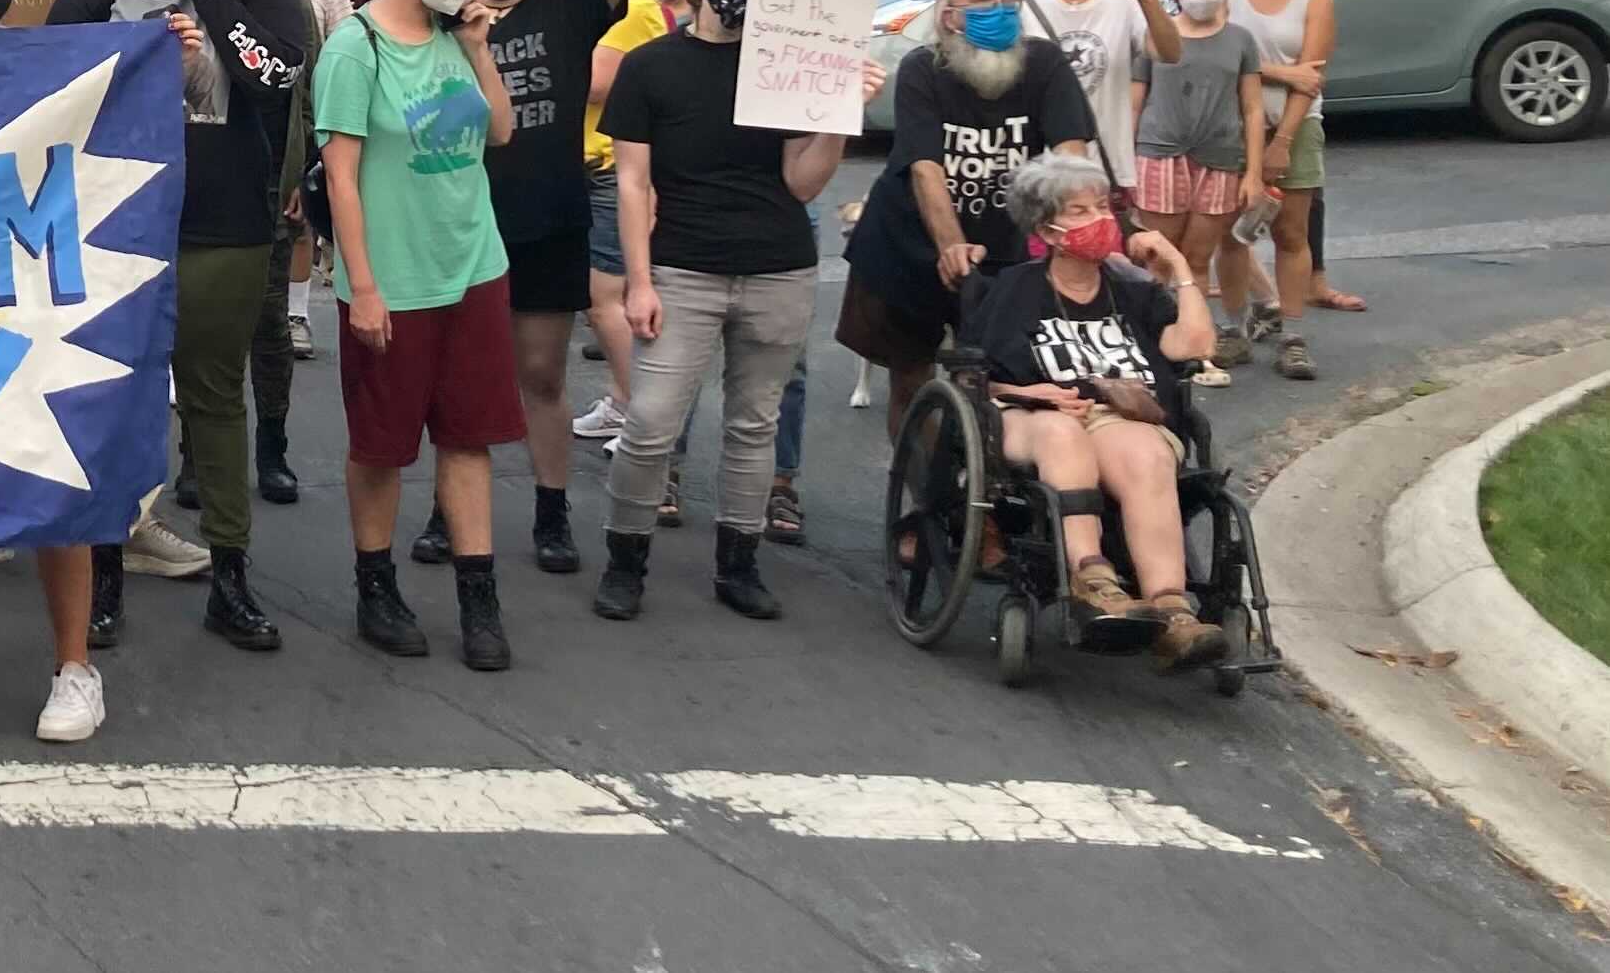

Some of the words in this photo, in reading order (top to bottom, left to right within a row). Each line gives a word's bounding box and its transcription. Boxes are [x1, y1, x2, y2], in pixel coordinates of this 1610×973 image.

[489, 32, 548, 65] ACK
[779, 44, 859, 73] FUCKING
[756, 64, 848, 96] SNATCH
[512, 99, 557, 130] TER
[943, 116, 1029, 154] TRUT
